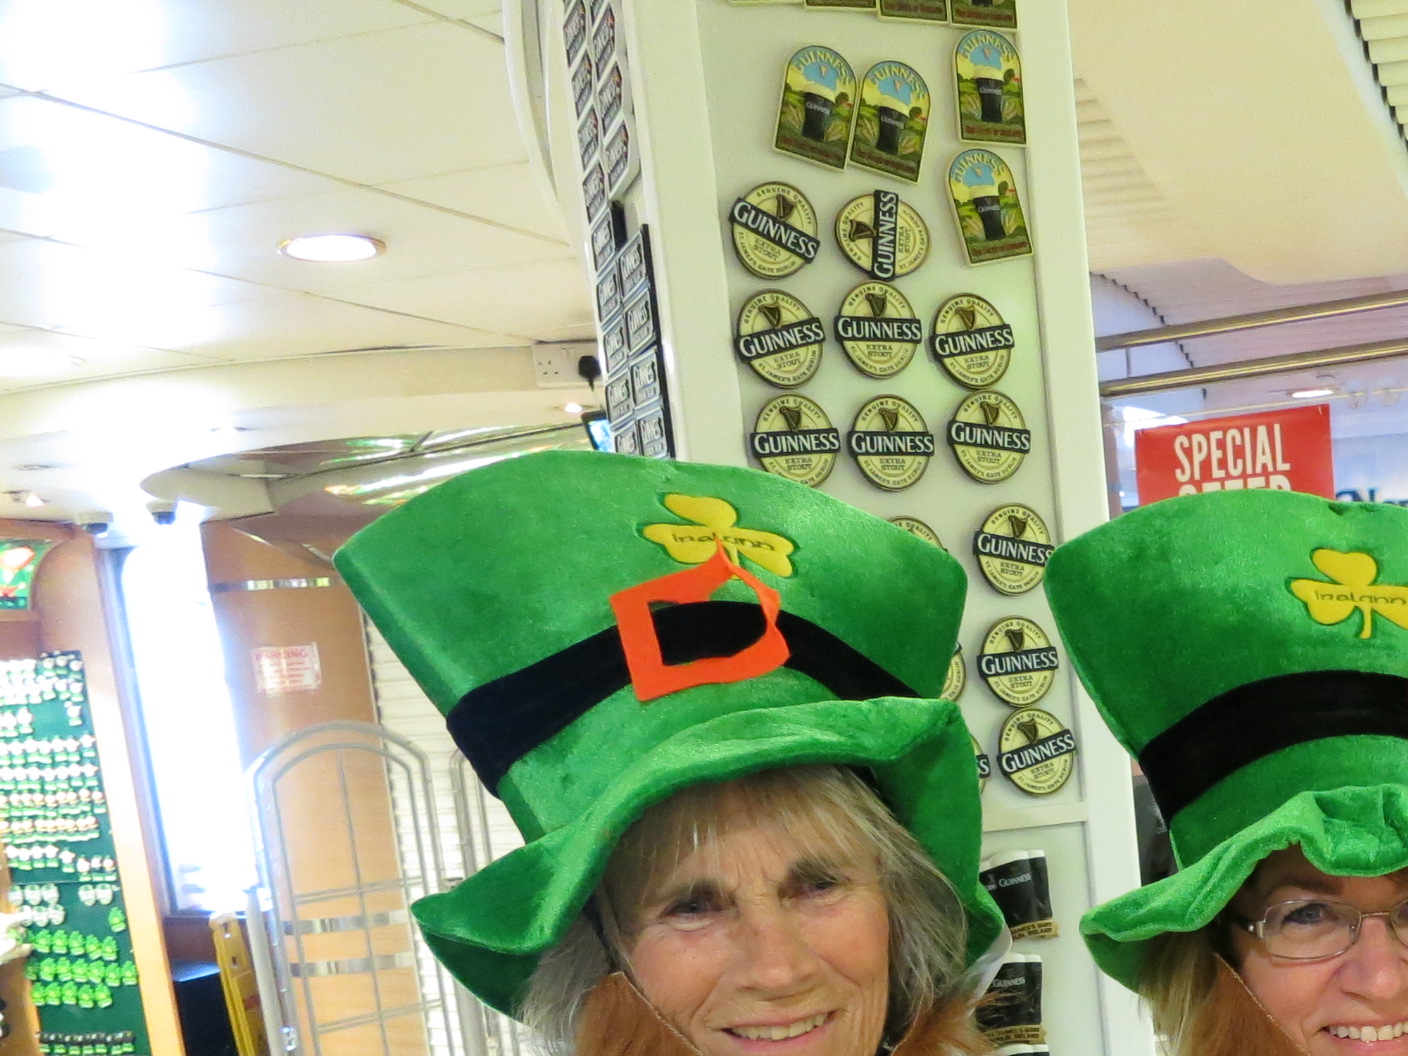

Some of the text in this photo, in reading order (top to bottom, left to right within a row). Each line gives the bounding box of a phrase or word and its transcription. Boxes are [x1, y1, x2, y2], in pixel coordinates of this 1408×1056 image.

[734, 201, 817, 258] GUINNESS
[874, 193, 896, 278] GUINNESS
[739, 323, 823, 357] GUINNESS
[838, 318, 921, 340] GUINNESS
[935, 328, 1013, 355] GUINNESS
[755, 433, 839, 454] GUINNESS
[851, 433, 933, 453] GUINNESS
[951, 423, 1030, 450] GUINNESS
[1174, 423, 1291, 482] SPECIAL
[981, 651, 1058, 675] GUINNESS
[1001, 734, 1075, 772] GUINNESS
[999, 873, 1031, 887] GUINNESS
[993, 977, 1025, 987] GUINNESS
